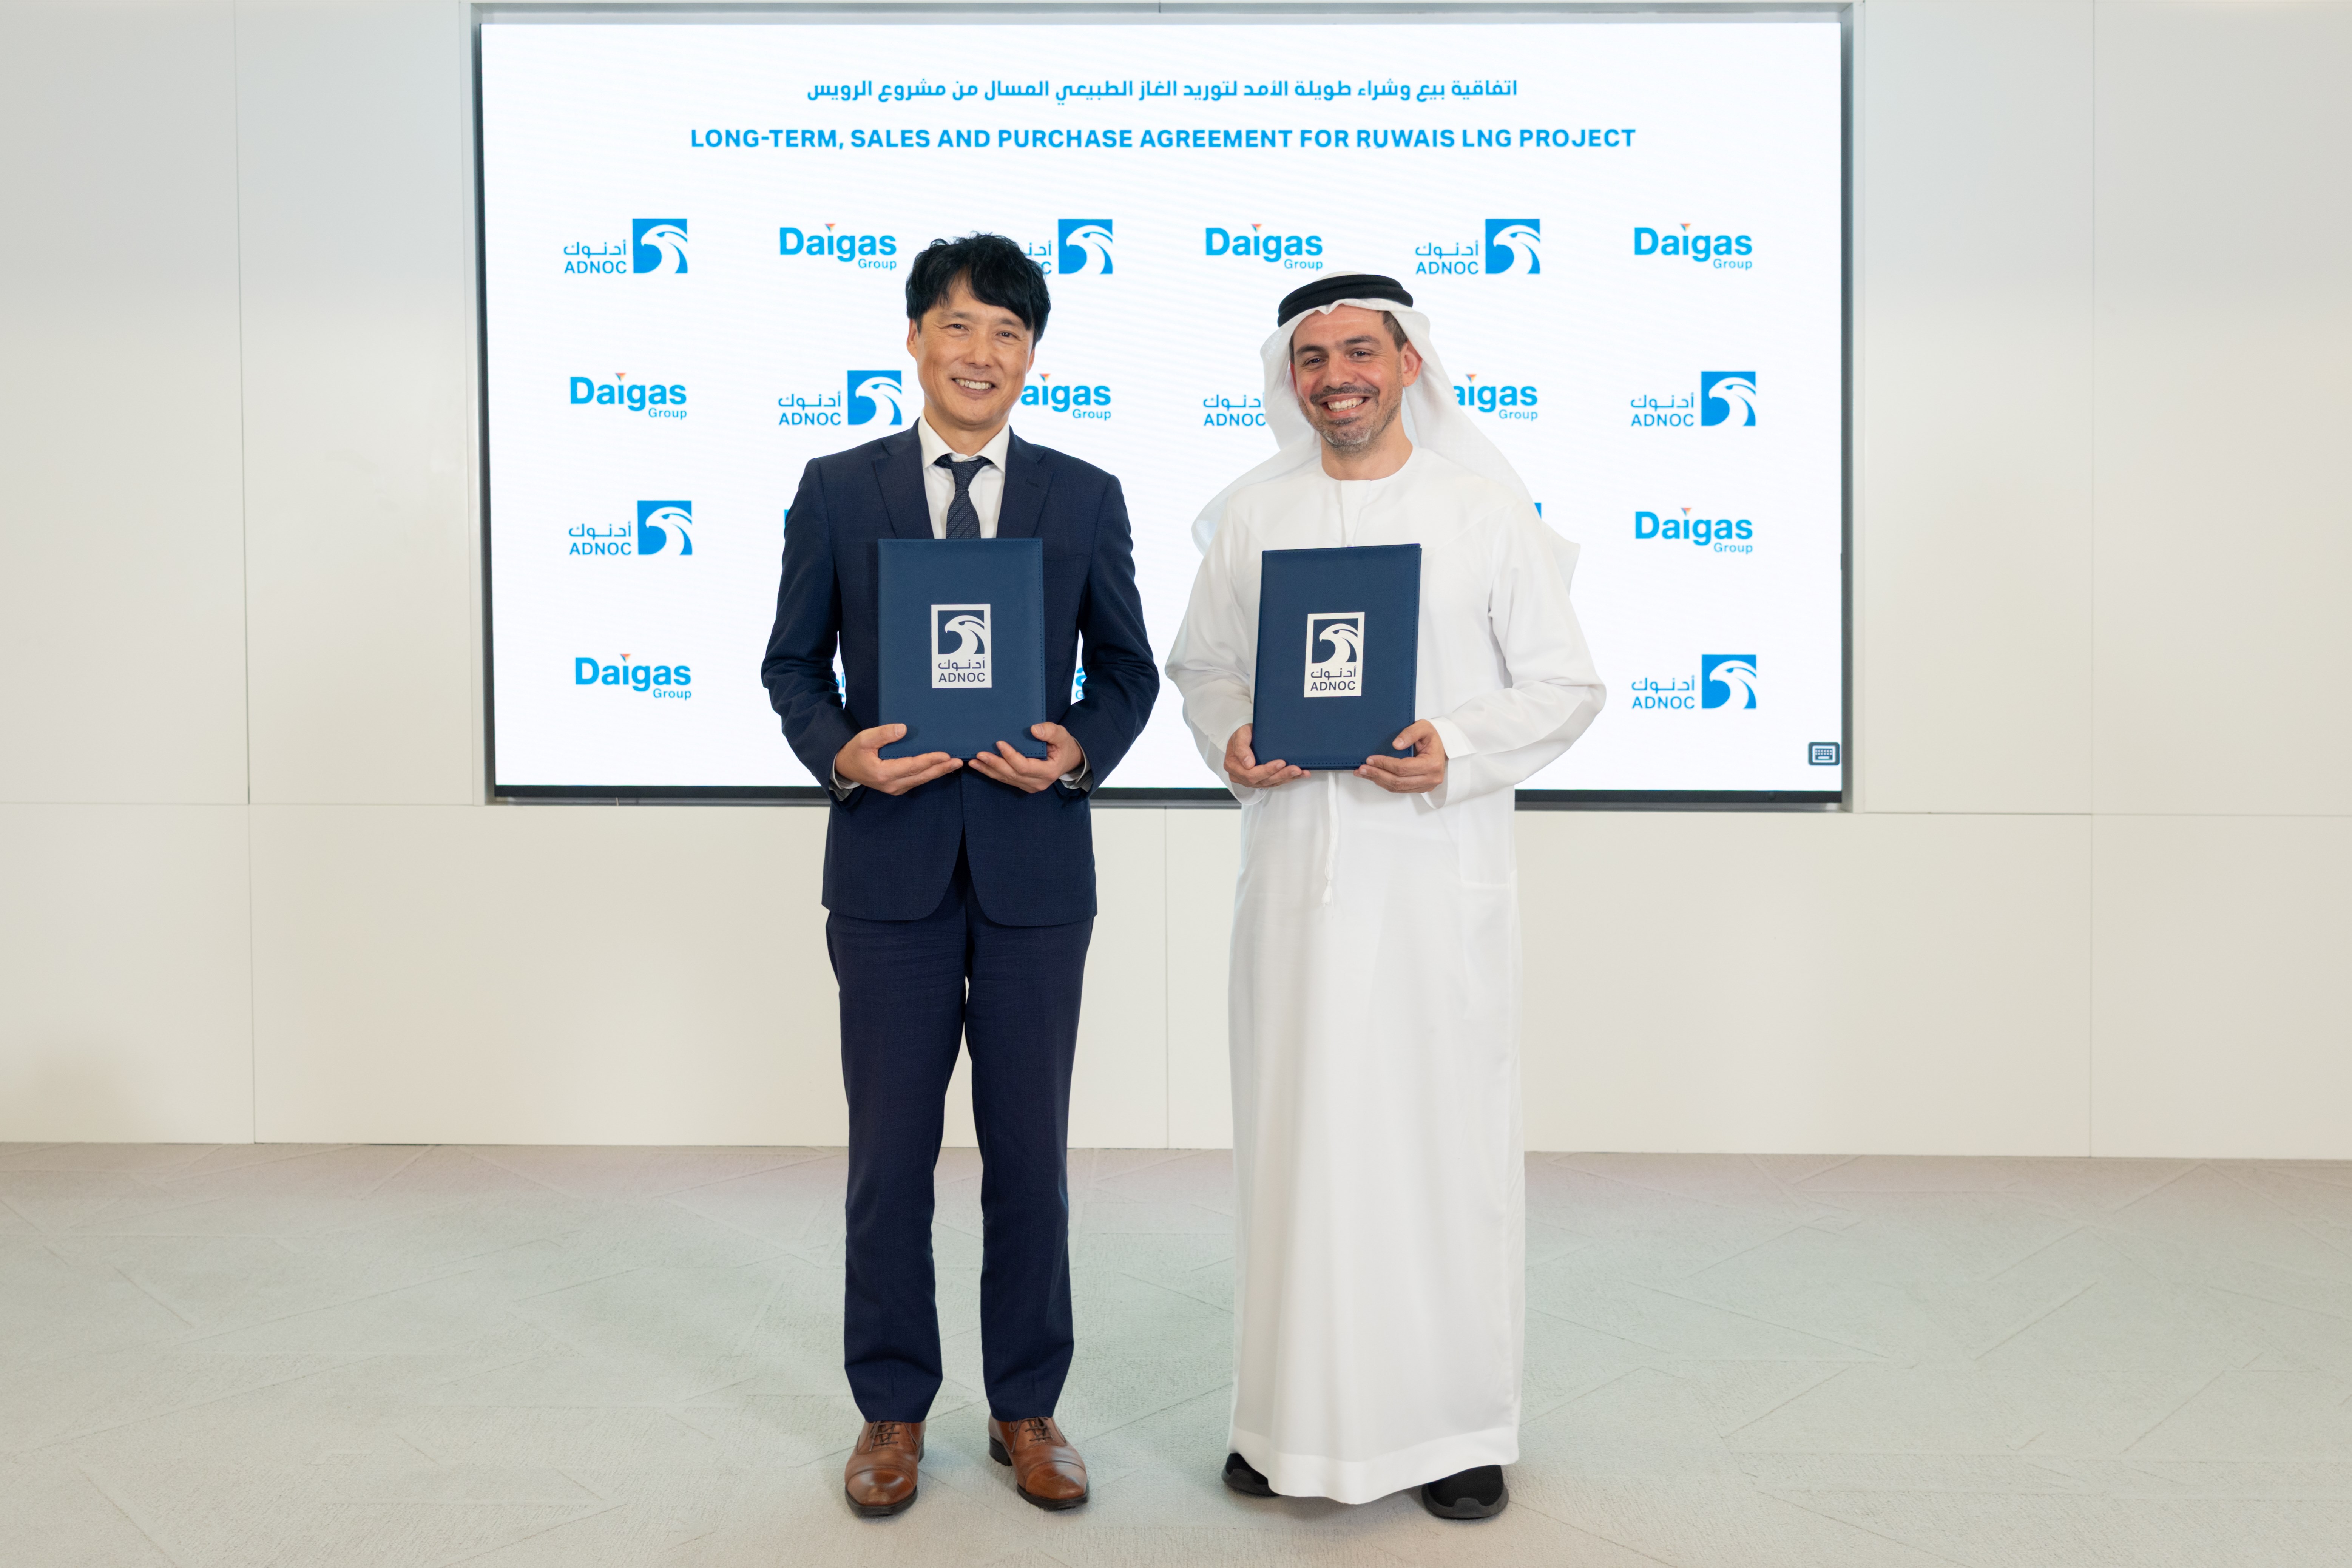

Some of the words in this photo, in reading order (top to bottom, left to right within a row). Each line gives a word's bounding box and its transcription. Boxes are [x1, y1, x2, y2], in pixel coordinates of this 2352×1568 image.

[807, 80, 872, 101] الرويس
[878, 79, 946, 102] مشروع
[952, 81, 978, 101] من
[985, 80, 1049, 101] المسال
[1056, 80, 1133, 105] الطبيعي
[1139, 80, 1177, 101] الغاز
[1184, 80, 1237, 101] لتوريد
[1244, 80, 1288, 96] الأمد
[1295, 80, 1351, 101] طويلة
[1358, 79, 1411, 101] وشراء
[1416, 85, 1445, 102] بيع
[1451, 80, 1517, 100] اتفاقية
[691, 129, 844, 150] LONG-TERM,
[851, 129, 930, 148] SALES
[937, 130, 990, 147] AND
[999, 130, 1133, 148] PURCHASE
[1140, 130, 1293, 148] AGREEMENT
[1300, 130, 1349, 148] FOR
[1357, 129, 1455, 148] RUWAIS
[1462, 129, 1511, 147] LNG
[1520, 129, 1636, 147] PROJECT
[563, 239, 626, 259] أدنوك
[780, 223, 897, 262] Daigas
[1024, 240, 1051, 256] أدن
[1205, 223, 1323, 262] Daigas
[1415, 240, 1478, 259] أدنوك
[1634, 223, 1752, 262] Daigas
[564, 261, 627, 274] ADNOC
[858, 258, 897, 270] Group
[1284, 259, 1323, 270] Group
[1416, 261, 1478, 275] ADNOC
[1713, 259, 1752, 270] Group
[570, 373, 687, 411] Daigas
[778, 391, 841, 411] أدنوك
[1021, 374, 1111, 412] aigas
[1453, 374, 1537, 412] aigas
[1631, 393, 1694, 411] أدنوك
[648, 407, 687, 420] Group
[779, 412, 841, 426] ADNOC
[1073, 409, 1111, 421] Group
[1204, 414, 1266, 426] ADNOC
[1499, 409, 1538, 421] Group
[1631, 414, 1694, 427] ADNOC
[569, 521, 631, 540] أدنوك
[1635, 507, 1753, 546] Daigas
[569, 542, 631, 555] ADNOC
[1714, 543, 1753, 554] Group
[575, 653, 691, 692] Daigas
[938, 657, 985, 672] أدنوك
[1311, 665, 1357, 681] أدنوك
[938, 673, 985, 682] ADNOC
[1310, 681, 1355, 691] ADNOC
[1631, 676, 1694, 694] أدنوك
[653, 688, 691, 700] Group
[1632, 696, 1694, 709] ADNOC
